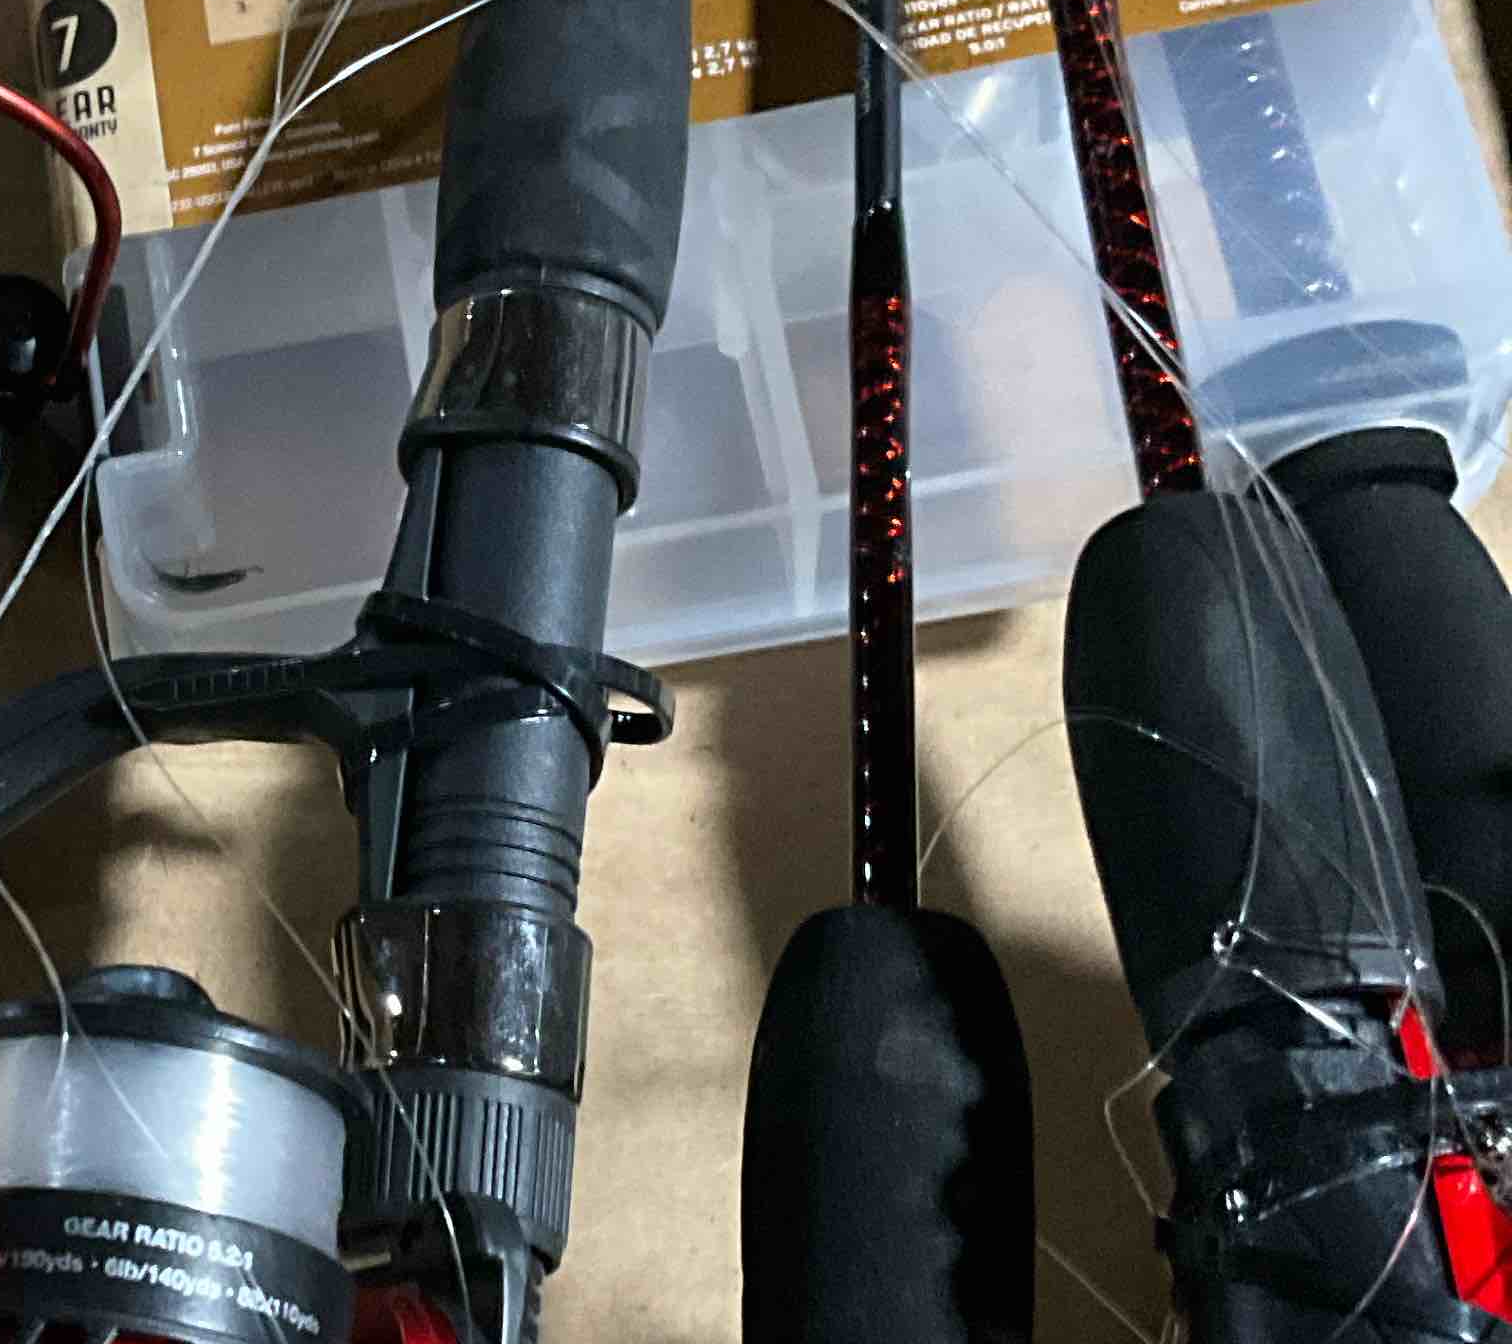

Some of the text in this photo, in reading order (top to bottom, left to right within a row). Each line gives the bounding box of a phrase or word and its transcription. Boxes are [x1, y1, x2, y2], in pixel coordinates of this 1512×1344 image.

[50, 12, 80, 73] 7
[55, 84, 117, 122] EAR
[64, 1216, 130, 1242] GEAR
[134, 1222, 205, 1257] RATIO
[104, 1254, 223, 1300] 6lb/140yds
